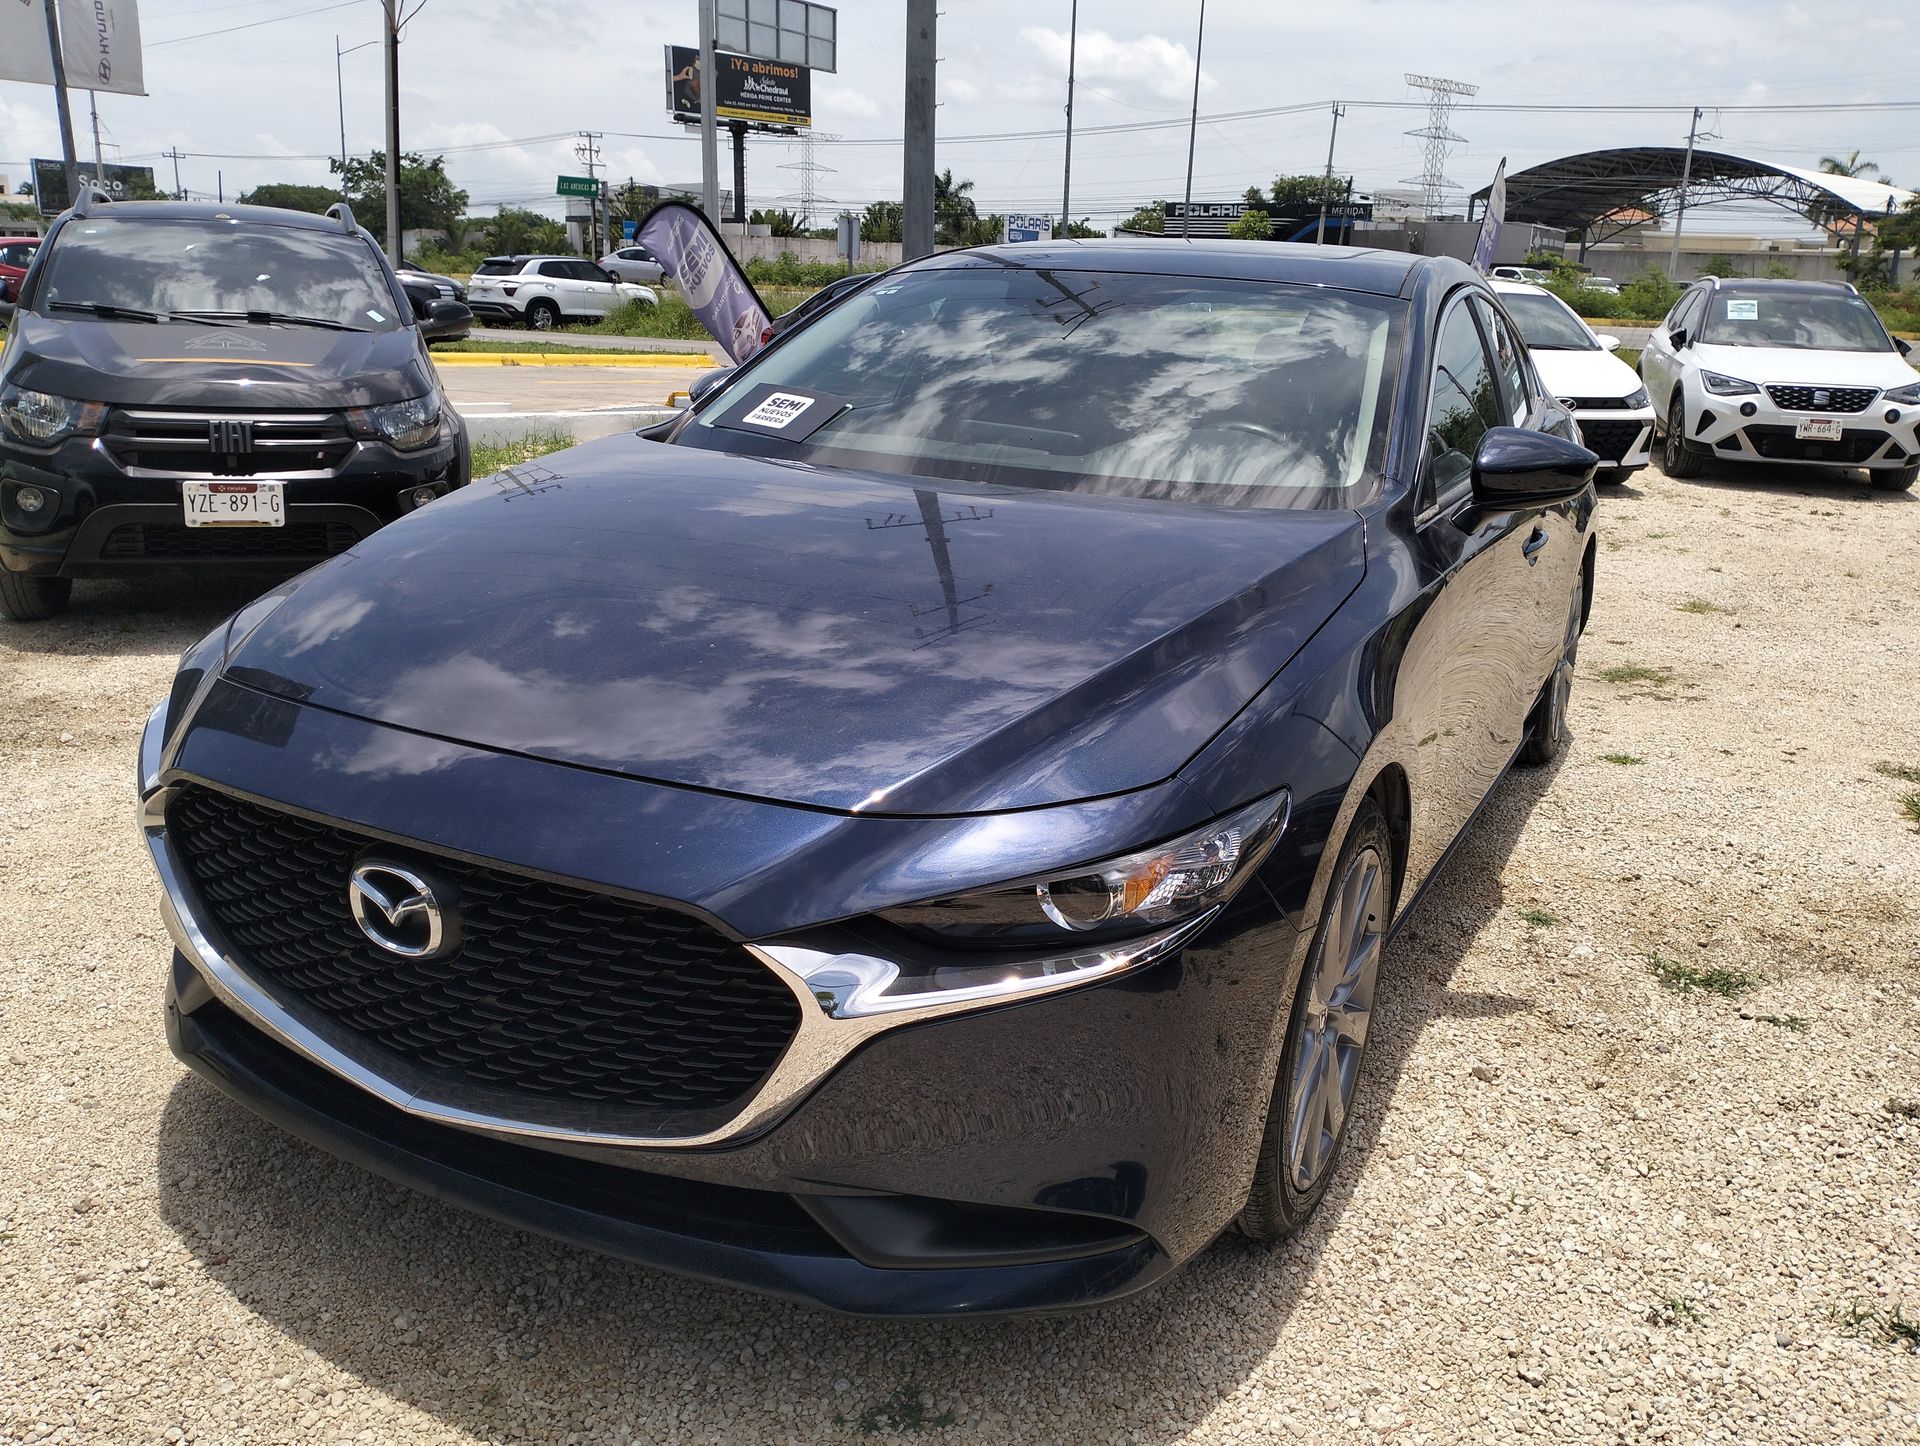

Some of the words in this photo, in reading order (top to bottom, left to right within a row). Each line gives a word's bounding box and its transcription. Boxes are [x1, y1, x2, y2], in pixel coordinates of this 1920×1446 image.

[731, 58, 749, 72] ¡Ya
[752, 61, 798, 79] abrimos!
[560, 181, 569, 190] LAS
[1174, 204, 1250, 217] POLARIS
[1009, 215, 1050, 232] POLARIS
[679, 230, 709, 285] SEMI
[688, 244, 716, 295] NUEVOS
[758, 407, 794, 418] NUEVOS
[767, 397, 806, 412] SEMI
[751, 413, 785, 424] FARRERA
[209, 420, 254, 453] FIAT
[188, 494, 280, 513] YZE-891-G
